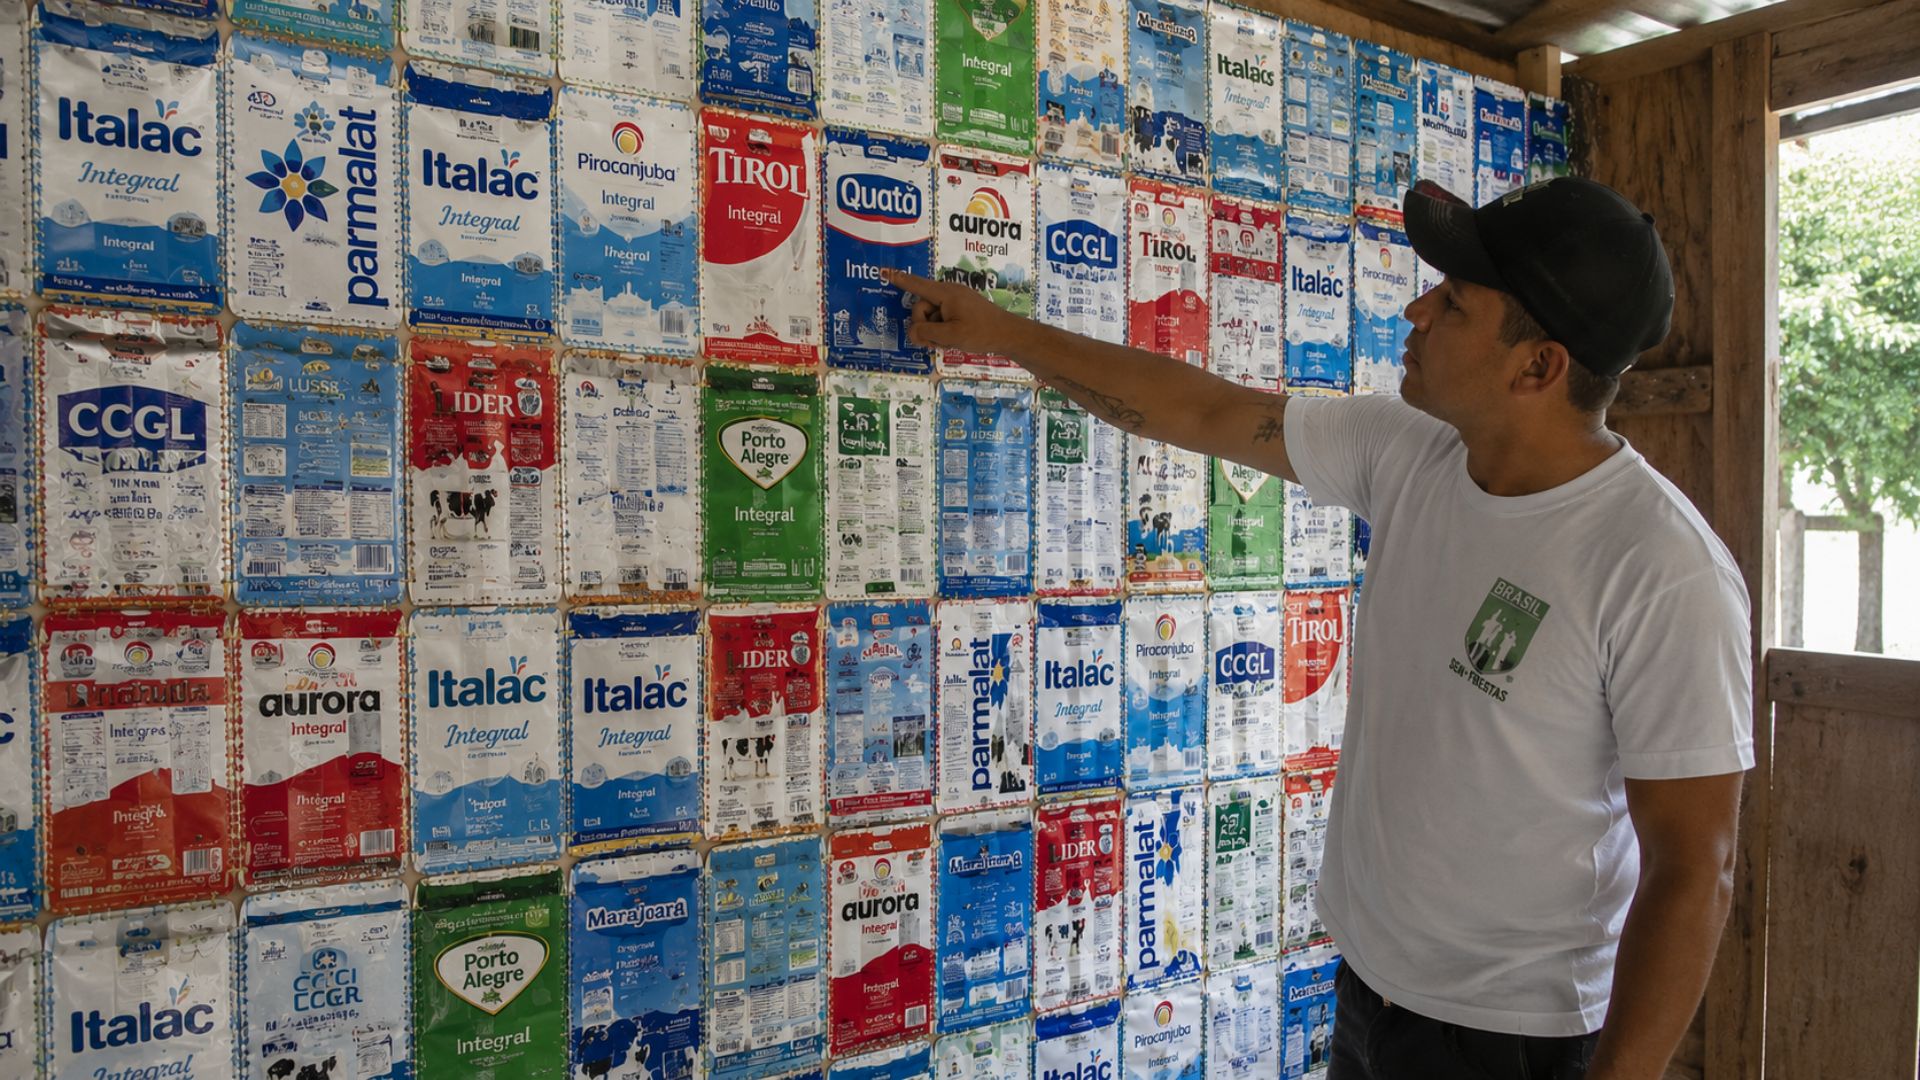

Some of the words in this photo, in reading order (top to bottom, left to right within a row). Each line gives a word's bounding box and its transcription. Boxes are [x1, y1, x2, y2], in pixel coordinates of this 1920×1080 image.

[962, 53, 1012, 78] Integral
[58, 97, 202, 157] Italac
[78, 160, 180, 195] Integral
[423, 149, 540, 200] Italac
[338, 105, 389, 310] parmalat
[602, 190, 655, 212] Integral
[728, 205, 781, 226] Integral
[438, 204, 520, 234] Integral
[949, 212, 1022, 241] aurora
[103, 236, 155, 251] Integral
[965, 238, 1008, 257] Integral
[1051, 229, 1112, 263] CCGL
[1291, 265, 1344, 298] Italac
[69, 402, 196, 441] CCGL
[741, 430, 786, 449] Porto
[741, 449, 789, 467] Alegre
[735, 506, 795, 526] Integral
[1494, 580, 1541, 617] BRASIL
[1287, 617, 1344, 648] TIROL
[1045, 659, 1114, 690] Italac
[1219, 653, 1270, 675] CCGL
[428, 668, 547, 709] Italac
[584, 676, 688, 714] Italac
[259, 689, 381, 719] aurora
[968, 637, 992, 791] parmalat
[1054, 699, 1103, 719] Integral
[291, 720, 347, 739] Integral
[444, 720, 530, 748] Integral
[598, 724, 672, 748] Integral
[842, 893, 919, 922] aurora
[1133, 820, 1160, 970] parmalat
[862, 920, 898, 936] Integral
[464, 949, 519, 972] Porto
[463, 967, 525, 990] Alegre
[71, 1001, 214, 1054] Italac
[457, 1026, 531, 1055] Integral
